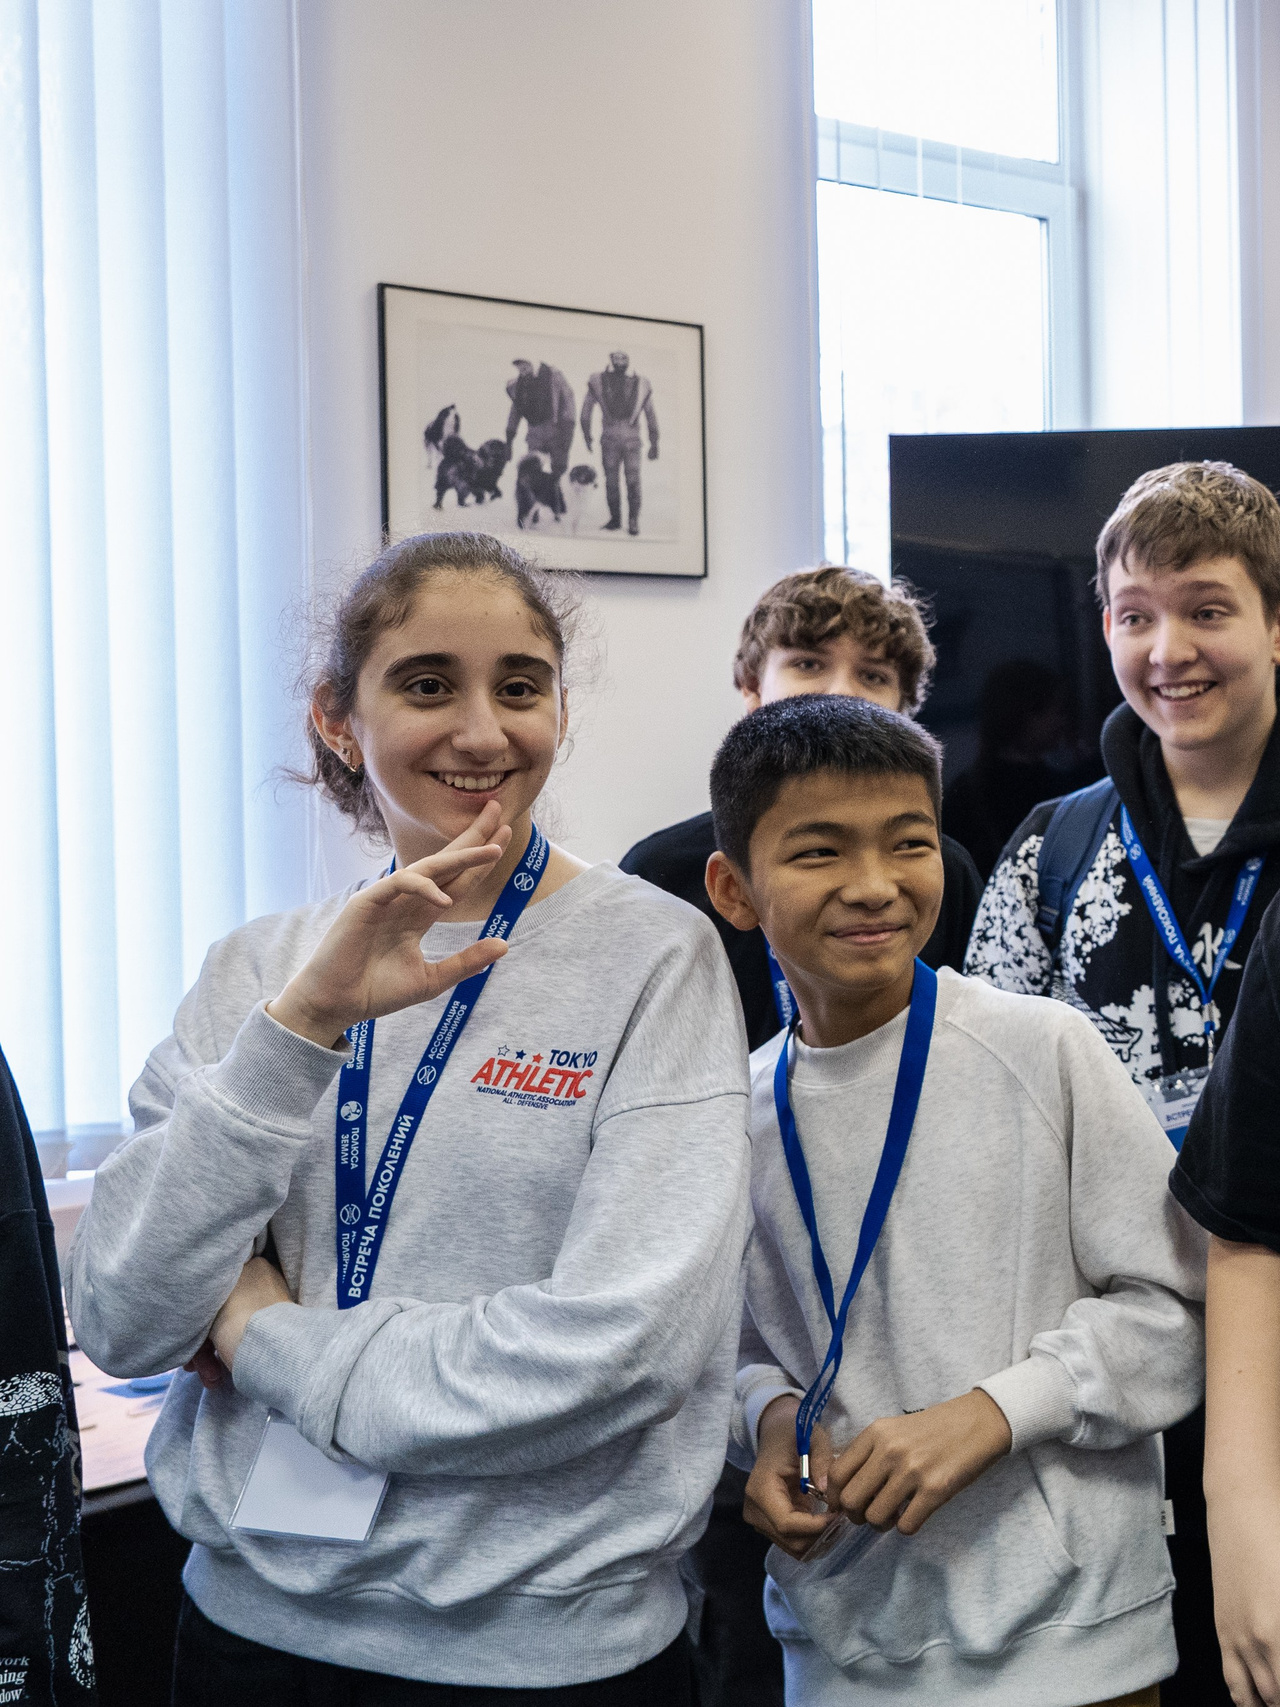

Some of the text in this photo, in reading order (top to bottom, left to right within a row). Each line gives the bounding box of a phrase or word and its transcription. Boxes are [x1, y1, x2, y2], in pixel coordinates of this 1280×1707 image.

[484, 913, 504, 941] ЛЮСА
[495, 920, 509, 940] МЛИ
[428, 1001, 460, 1060] АССОЦИАЦИЯ
[436, 1005, 467, 1060] ПОЛЯРНИКОВ
[549, 1049, 598, 1069] TOKYO
[470, 1057, 594, 1098] ATHLETIC
[476, 1086, 577, 1106] NATIONAL ATHLETIC ASSOCIATION
[502, 1097, 513, 1105] ALL
[517, 1101, 548, 1110] DEFENSIVE
[341, 1134, 349, 1165] ЗЕМЛИ
[350, 1128, 360, 1170] ПОЛЮСА
[348, 1114, 415, 1298] ВСТРЕЧА ПОКОЛЕНИЙ
[0, 1689, 23, 1703] dow
